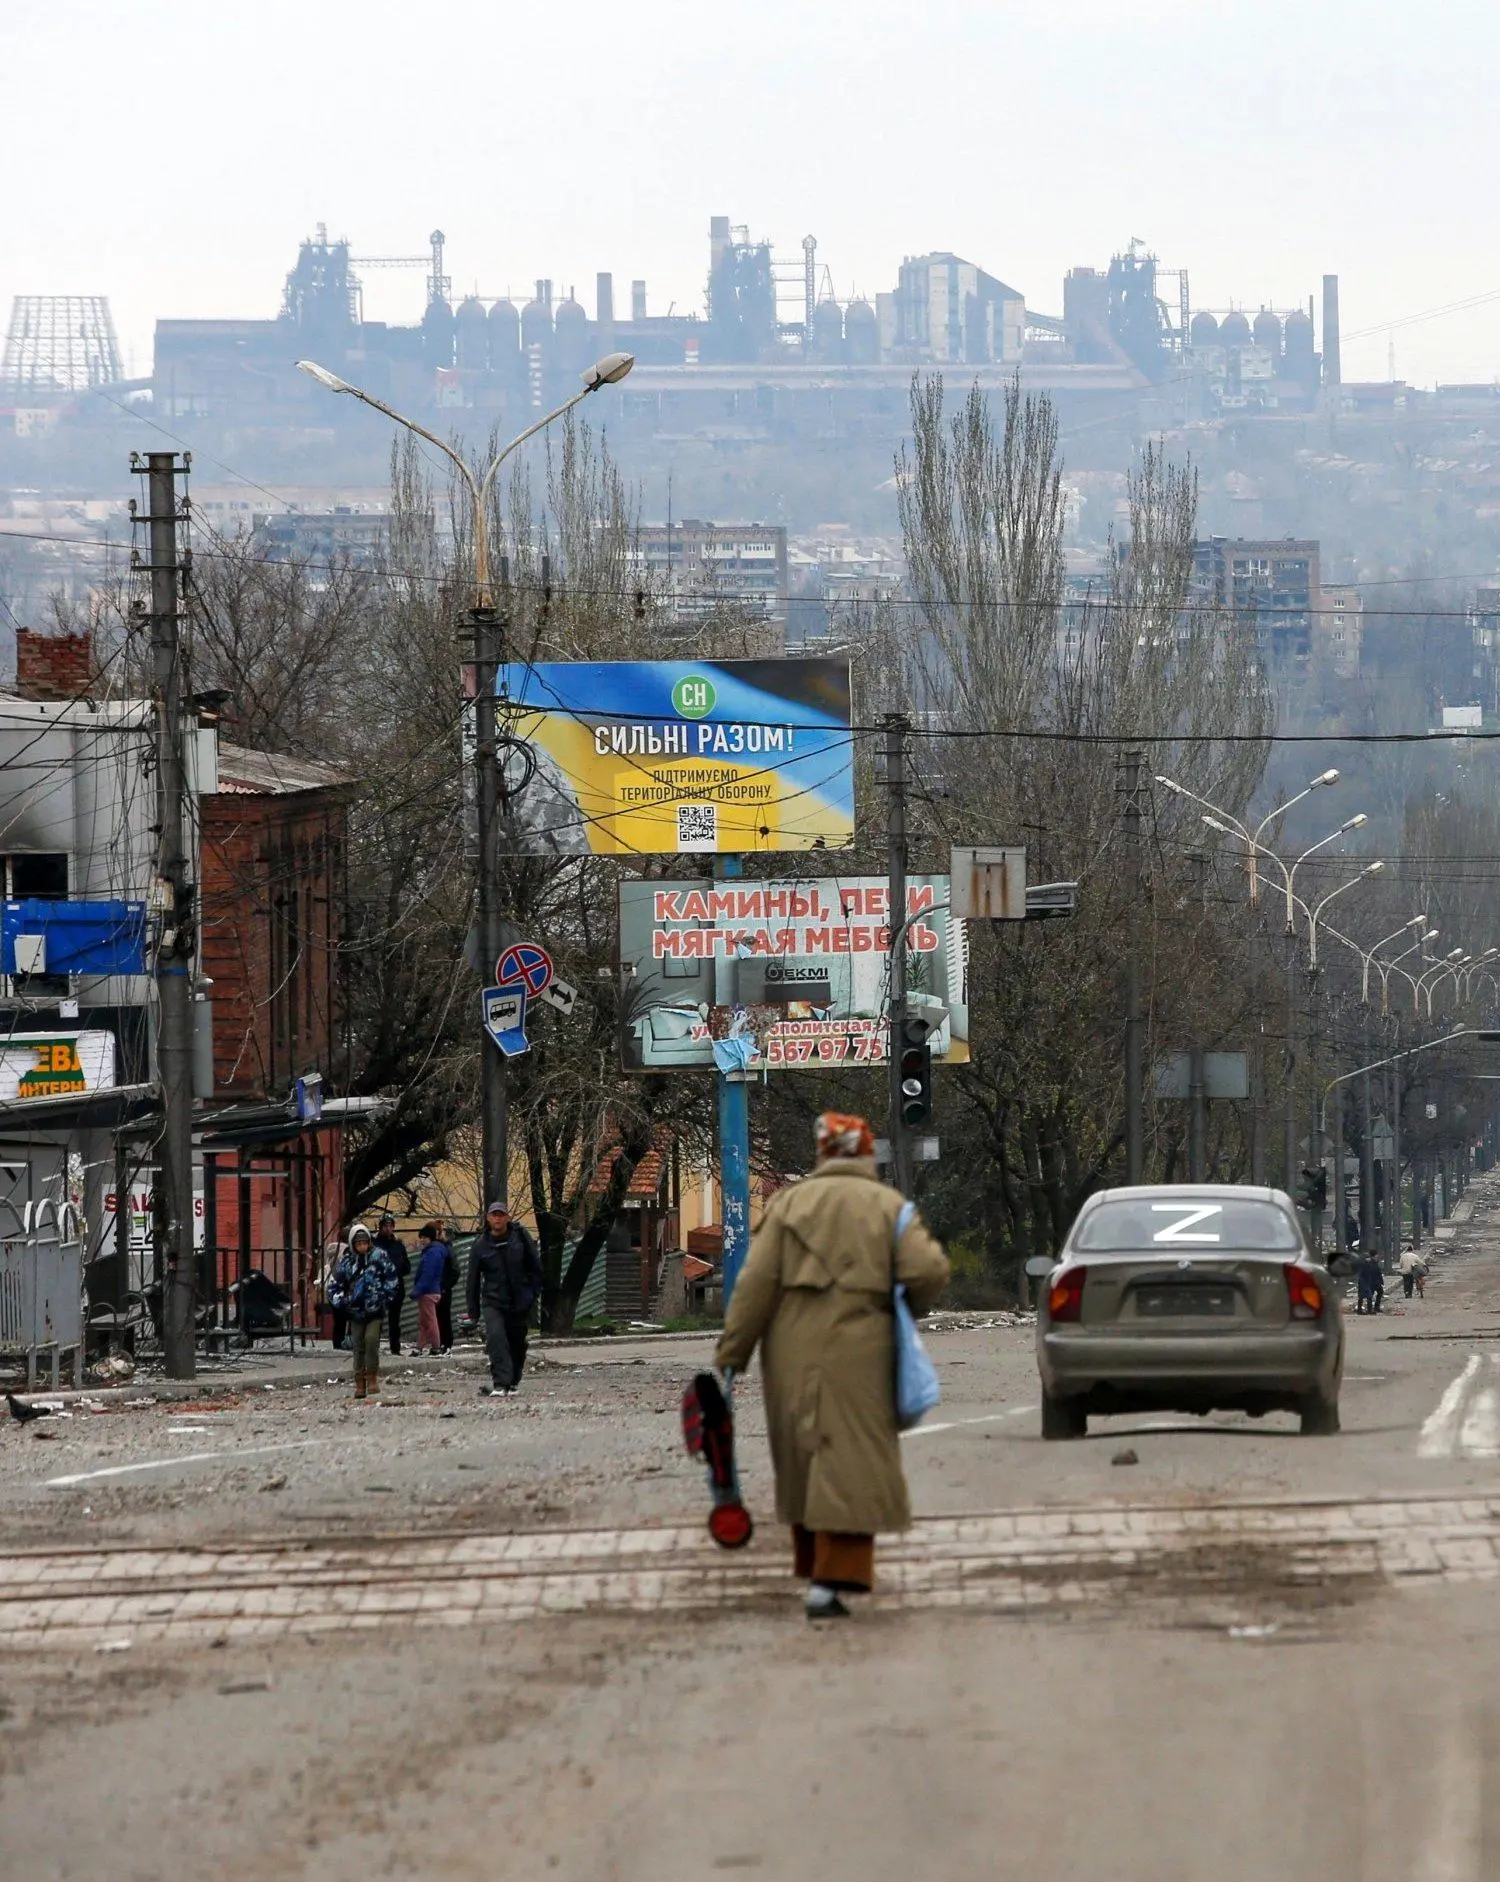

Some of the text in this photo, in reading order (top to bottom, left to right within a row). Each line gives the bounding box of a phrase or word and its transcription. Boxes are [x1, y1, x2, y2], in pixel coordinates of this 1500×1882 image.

[682, 683, 706, 706] СН
[594, 723, 795, 755] СИЛЬНІ РАЗОМ!
[653, 769, 738, 783] ПІДТРИМУЄМО
[621, 786, 713, 801] ТЕРИТОРІАЛЬНУ
[654, 884, 934, 922] КАМИНЫ, ПЕИ
[769, 1017, 876, 1037] ополитская,
[768, 1040, 814, 1063] 567
[818, 1037, 849, 1062] 97
[853, 1037, 884, 1060] 75
[1152, 1204, 1223, 1242] Z
